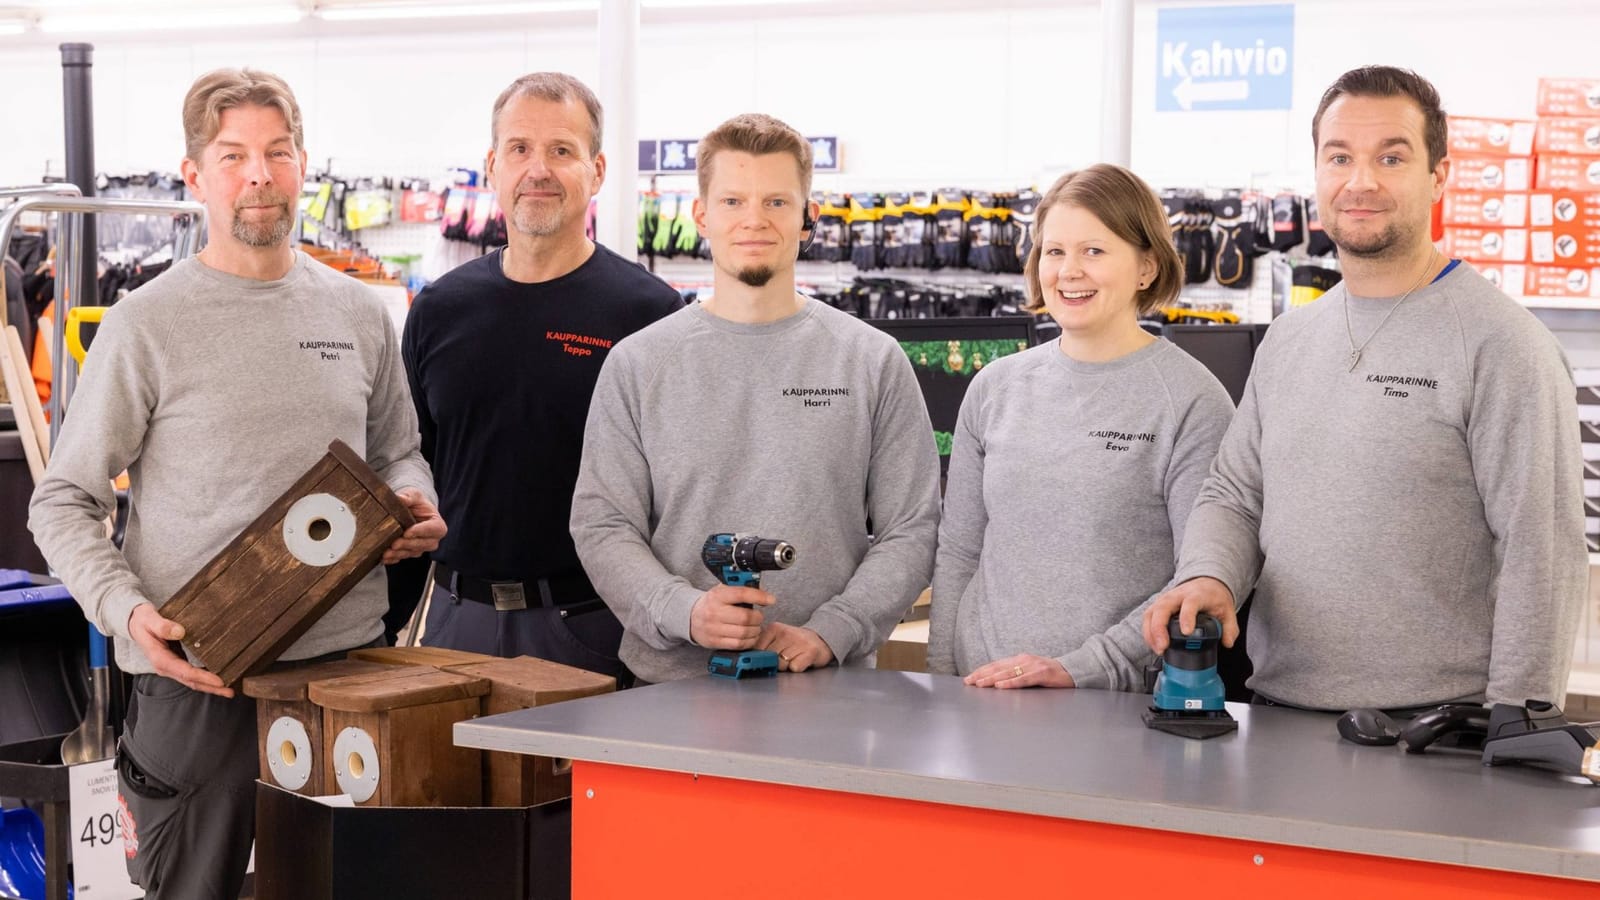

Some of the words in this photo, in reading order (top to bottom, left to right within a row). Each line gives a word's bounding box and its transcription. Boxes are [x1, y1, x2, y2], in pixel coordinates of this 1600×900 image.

[1162, 38, 1287, 78] Kahvio
[299, 341, 355, 351] KAUPPARINNE
[546, 331, 613, 349] KAUPPARINNE
[563, 343, 592, 356] Teppo
[320, 351, 341, 361] Petri
[1366, 374, 1439, 390] KAUPPARINNE
[782, 388, 850, 397] KAUPPARINNE
[1383, 386, 1409, 398] Timo
[804, 398, 831, 407] Harri
[1087, 430, 1157, 443] KAUPPARINNE
[1105, 441, 1130, 452] Eeva
[87, 774, 117, 787] LUMENTY
